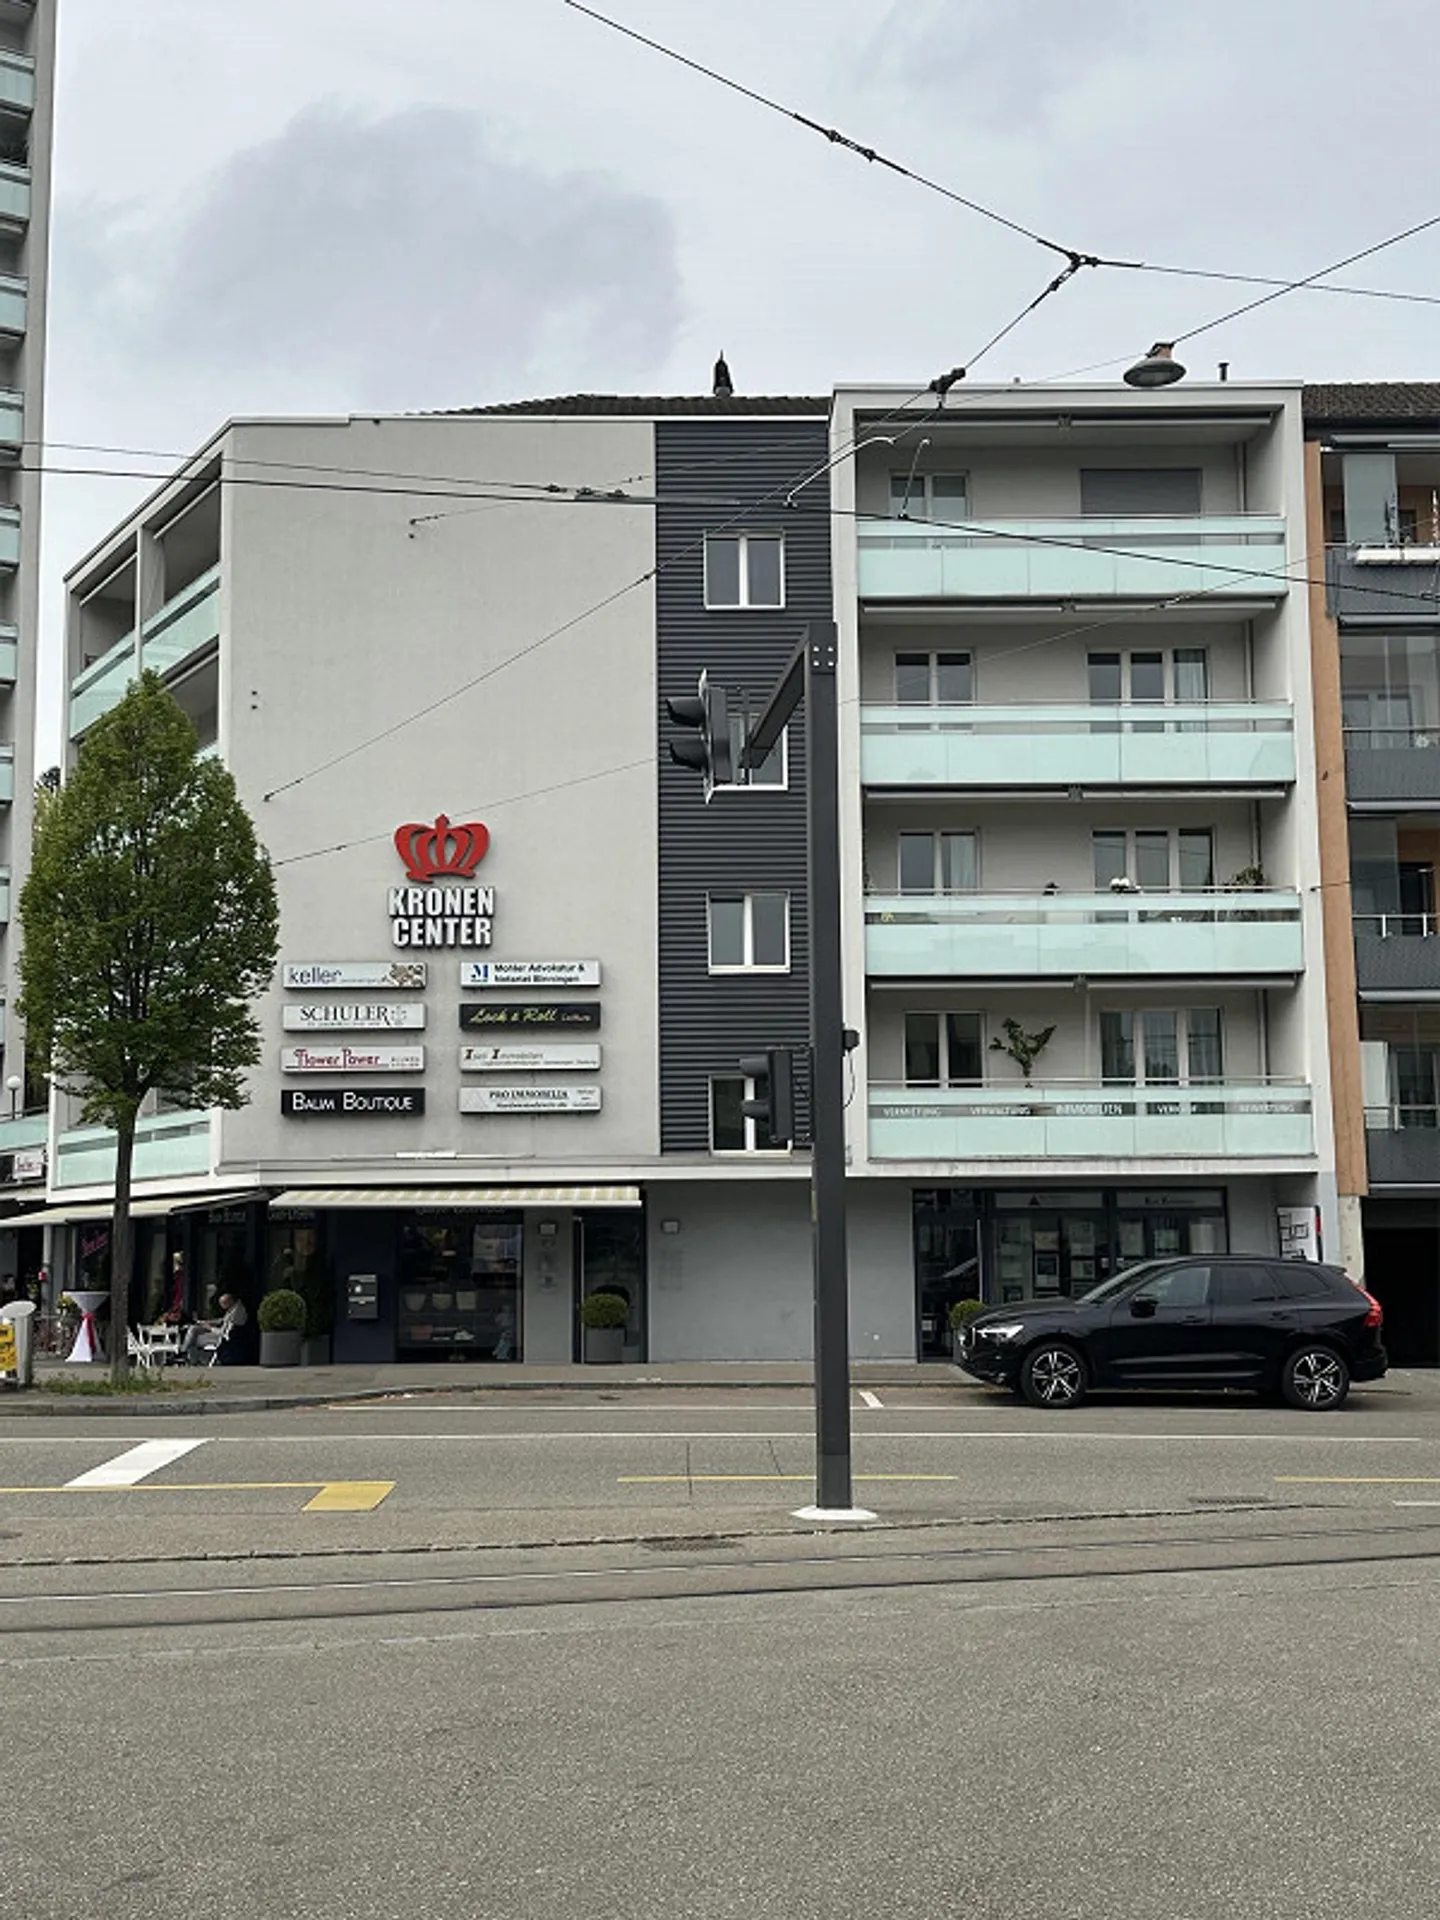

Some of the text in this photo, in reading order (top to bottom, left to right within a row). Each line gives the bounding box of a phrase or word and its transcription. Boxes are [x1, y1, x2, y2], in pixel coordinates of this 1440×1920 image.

[389, 888, 493, 915] KRONEN
[393, 917, 491, 945] CENTER
[289, 967, 341, 984] keller
[529, 964, 575, 973] Advokatur
[300, 1005, 390, 1025] SCHULER
[523, 1008, 558, 1022] Roll
[342, 1048, 380, 1068] Power
[343, 1092, 413, 1111] BOUTIQUE
